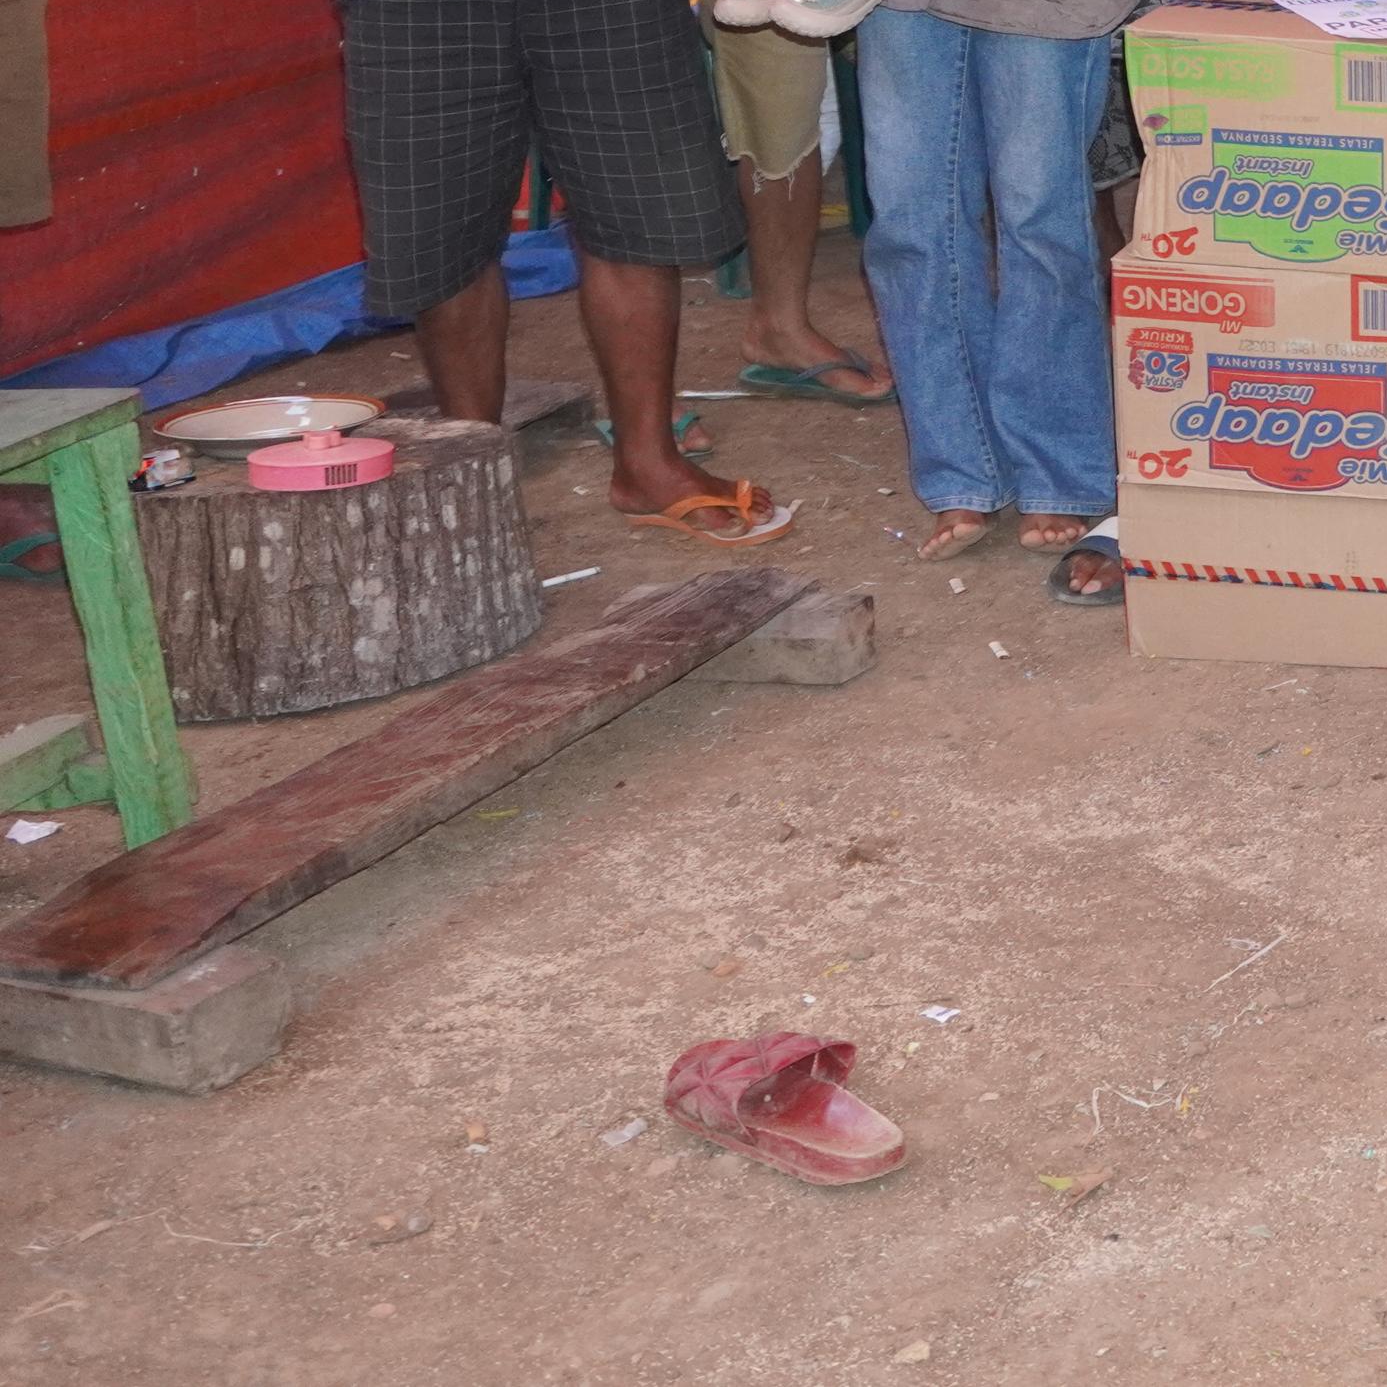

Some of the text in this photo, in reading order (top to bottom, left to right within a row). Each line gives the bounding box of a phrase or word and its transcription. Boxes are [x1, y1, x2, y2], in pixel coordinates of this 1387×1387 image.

[1220, 130, 1375, 150] JELAS TERASA SEDAPNYA
[1234, 157, 1311, 177] Instant
[1152, 226, 1199, 259] 20
[1122, 285, 1247, 317] GORENG
[1221, 319, 1241, 334] MI
[1139, 330, 1185, 344] KRIUK
[1216, 356, 1377, 374] JELAS TERASA SEDAPNYA
[1230, 382, 1313, 403] Instant
[1138, 447, 1193, 480] 20
